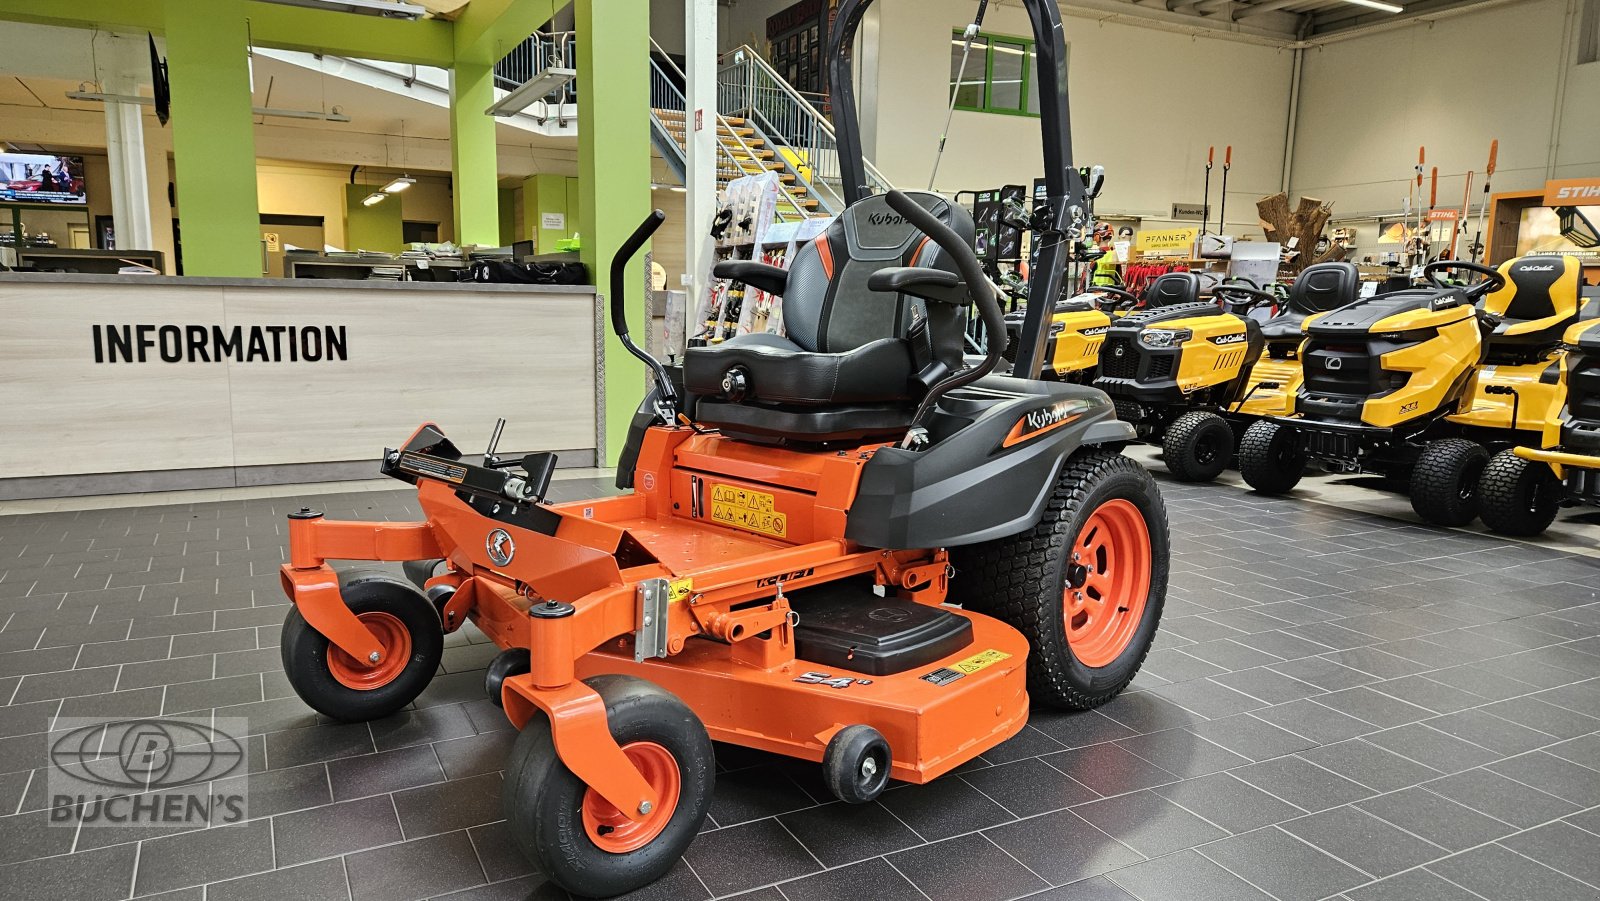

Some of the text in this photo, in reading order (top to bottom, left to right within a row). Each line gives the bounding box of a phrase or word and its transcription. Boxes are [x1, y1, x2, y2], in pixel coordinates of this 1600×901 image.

[1178, 208, 1203, 216] Kunden-WC
[1429, 211, 1456, 219] STIHL
[868, 212, 911, 225] Kubot
[1145, 234, 1187, 243] PFANNER
[1442, 295, 1456, 303] Cadet
[92, 324, 348, 363] INFORMATION
[1215, 333, 1245, 344] Cub Cadet
[1400, 400, 1419, 412] XT1
[1027, 403, 1067, 429] Kubota
[758, 568, 812, 587] K-LIFT
